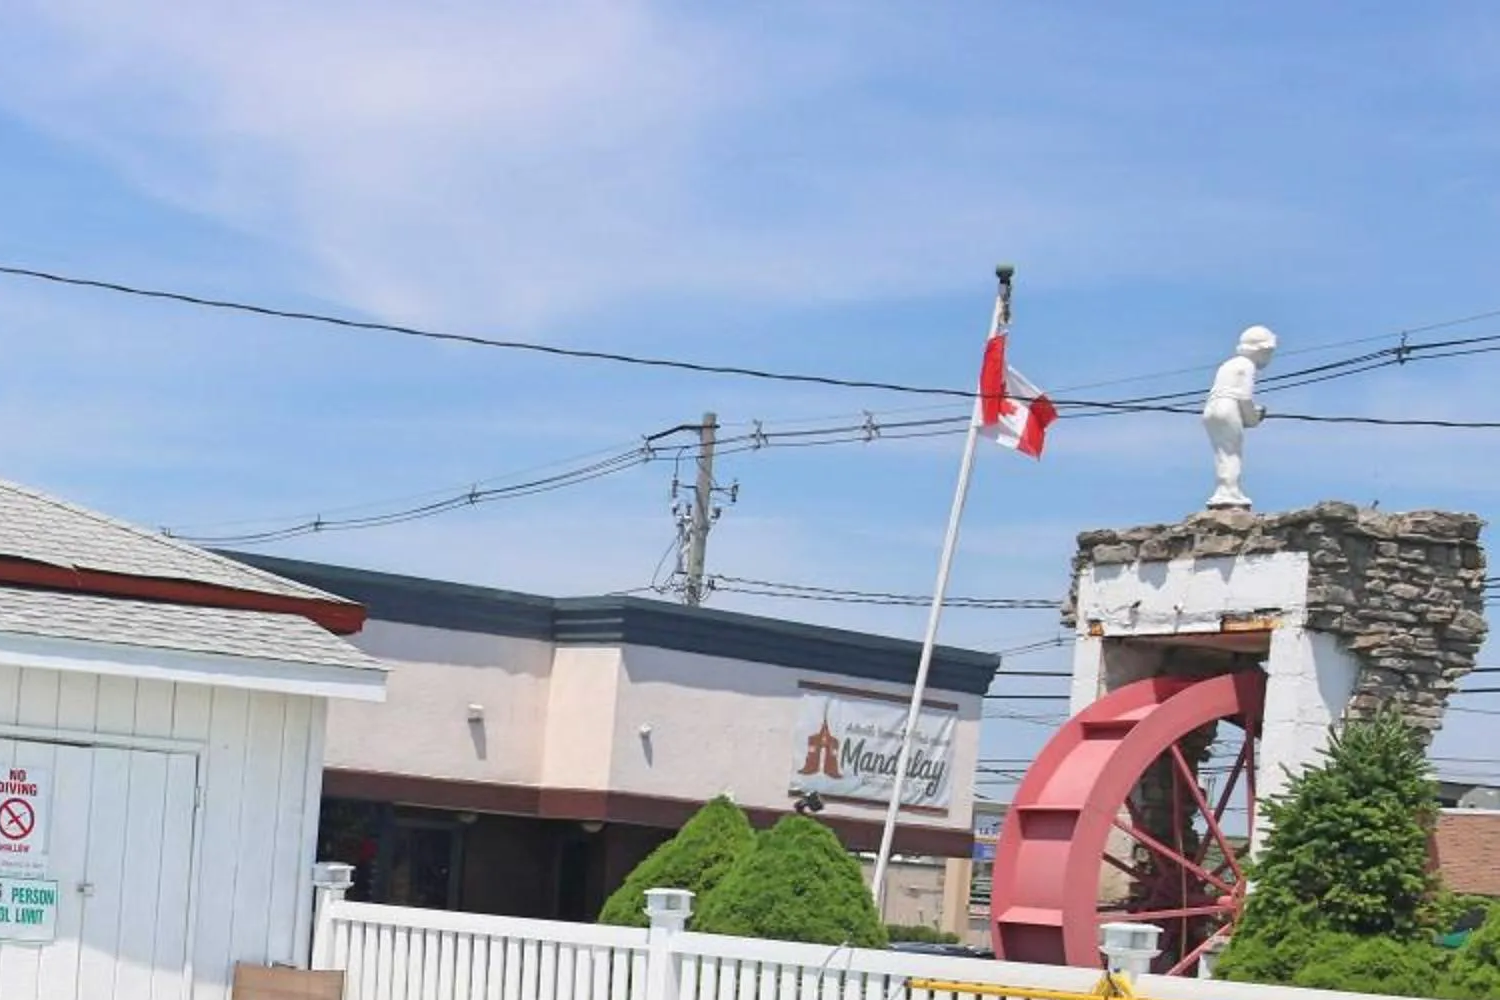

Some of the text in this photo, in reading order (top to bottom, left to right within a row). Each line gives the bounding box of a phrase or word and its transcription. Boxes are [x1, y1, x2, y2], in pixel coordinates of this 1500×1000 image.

[10, 769, 26, 782] NO
[11, 887, 55, 904] PERSON
[15, 907, 44, 924] LIMIT
